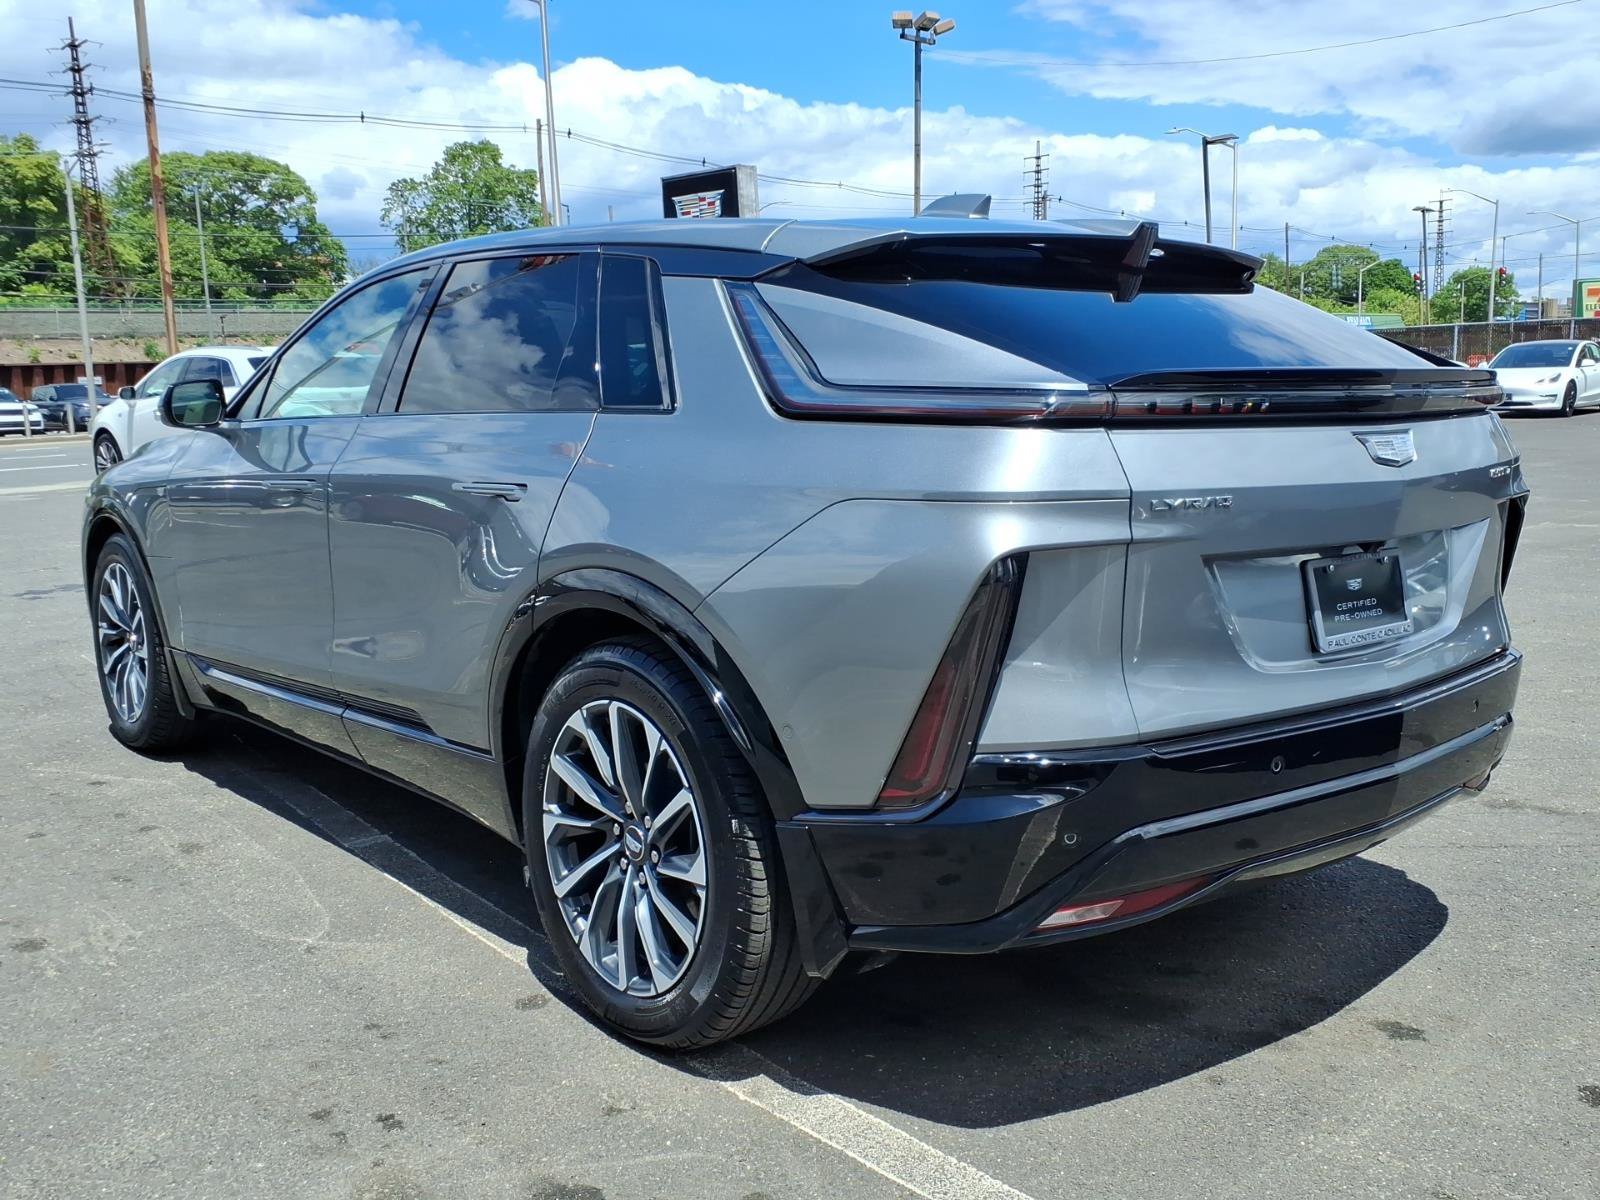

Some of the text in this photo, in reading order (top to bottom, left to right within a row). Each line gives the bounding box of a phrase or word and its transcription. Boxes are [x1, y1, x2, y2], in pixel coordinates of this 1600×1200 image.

[1151, 495, 1233, 511] LYRIQ
[1337, 597, 1377, 611] CERTIFIED
[1334, 608, 1383, 622] PRE-OWNED
[1327, 639, 1350, 649] PAUL
[1350, 633, 1377, 643] CONTE
